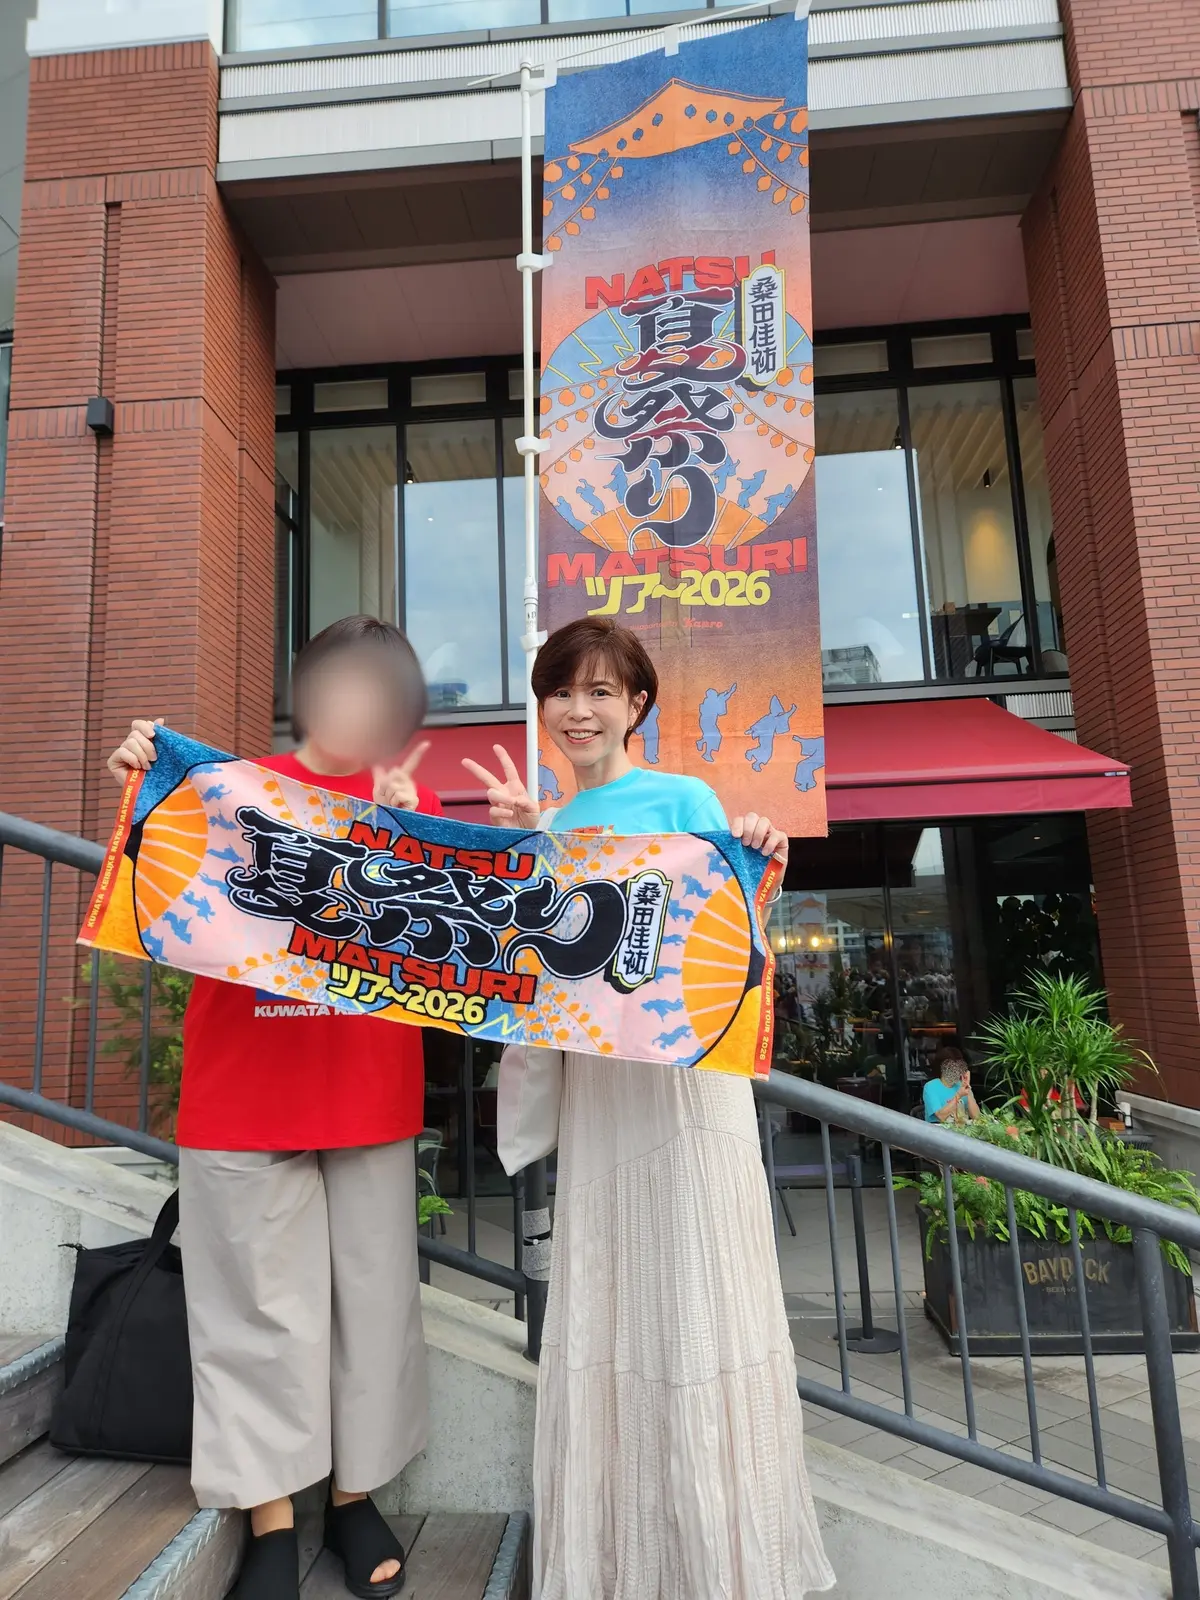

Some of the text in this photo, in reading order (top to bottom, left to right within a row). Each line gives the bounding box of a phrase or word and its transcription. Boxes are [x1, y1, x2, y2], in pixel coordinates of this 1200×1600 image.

[748, 277, 778, 375] 桑田佳祐
[594, 286, 747, 556] 夏祭り
[547, 537, 807, 587] MATSURI
[684, 617, 723, 629] Kanro
[87, 893, 105, 928] KUWATA
[101, 855, 115, 890] KEISUKE
[111, 824, 125, 853] NATSU
[120, 785, 133, 822] MATSURI
[350, 820, 535, 880] NATSU
[226, 809, 628, 981] 夏祭り
[759, 870, 776, 903] KUWATA
[622, 882, 662, 976] 桑田佳祐
[287, 924, 537, 1004] MATSURI
[765, 968, 773, 1006] MATSURI
[254, 1004, 331, 1018] KUWATA
[759, 1036, 769, 1061] 2026
[1022, 1257, 1111, 1285] BAYDCK
